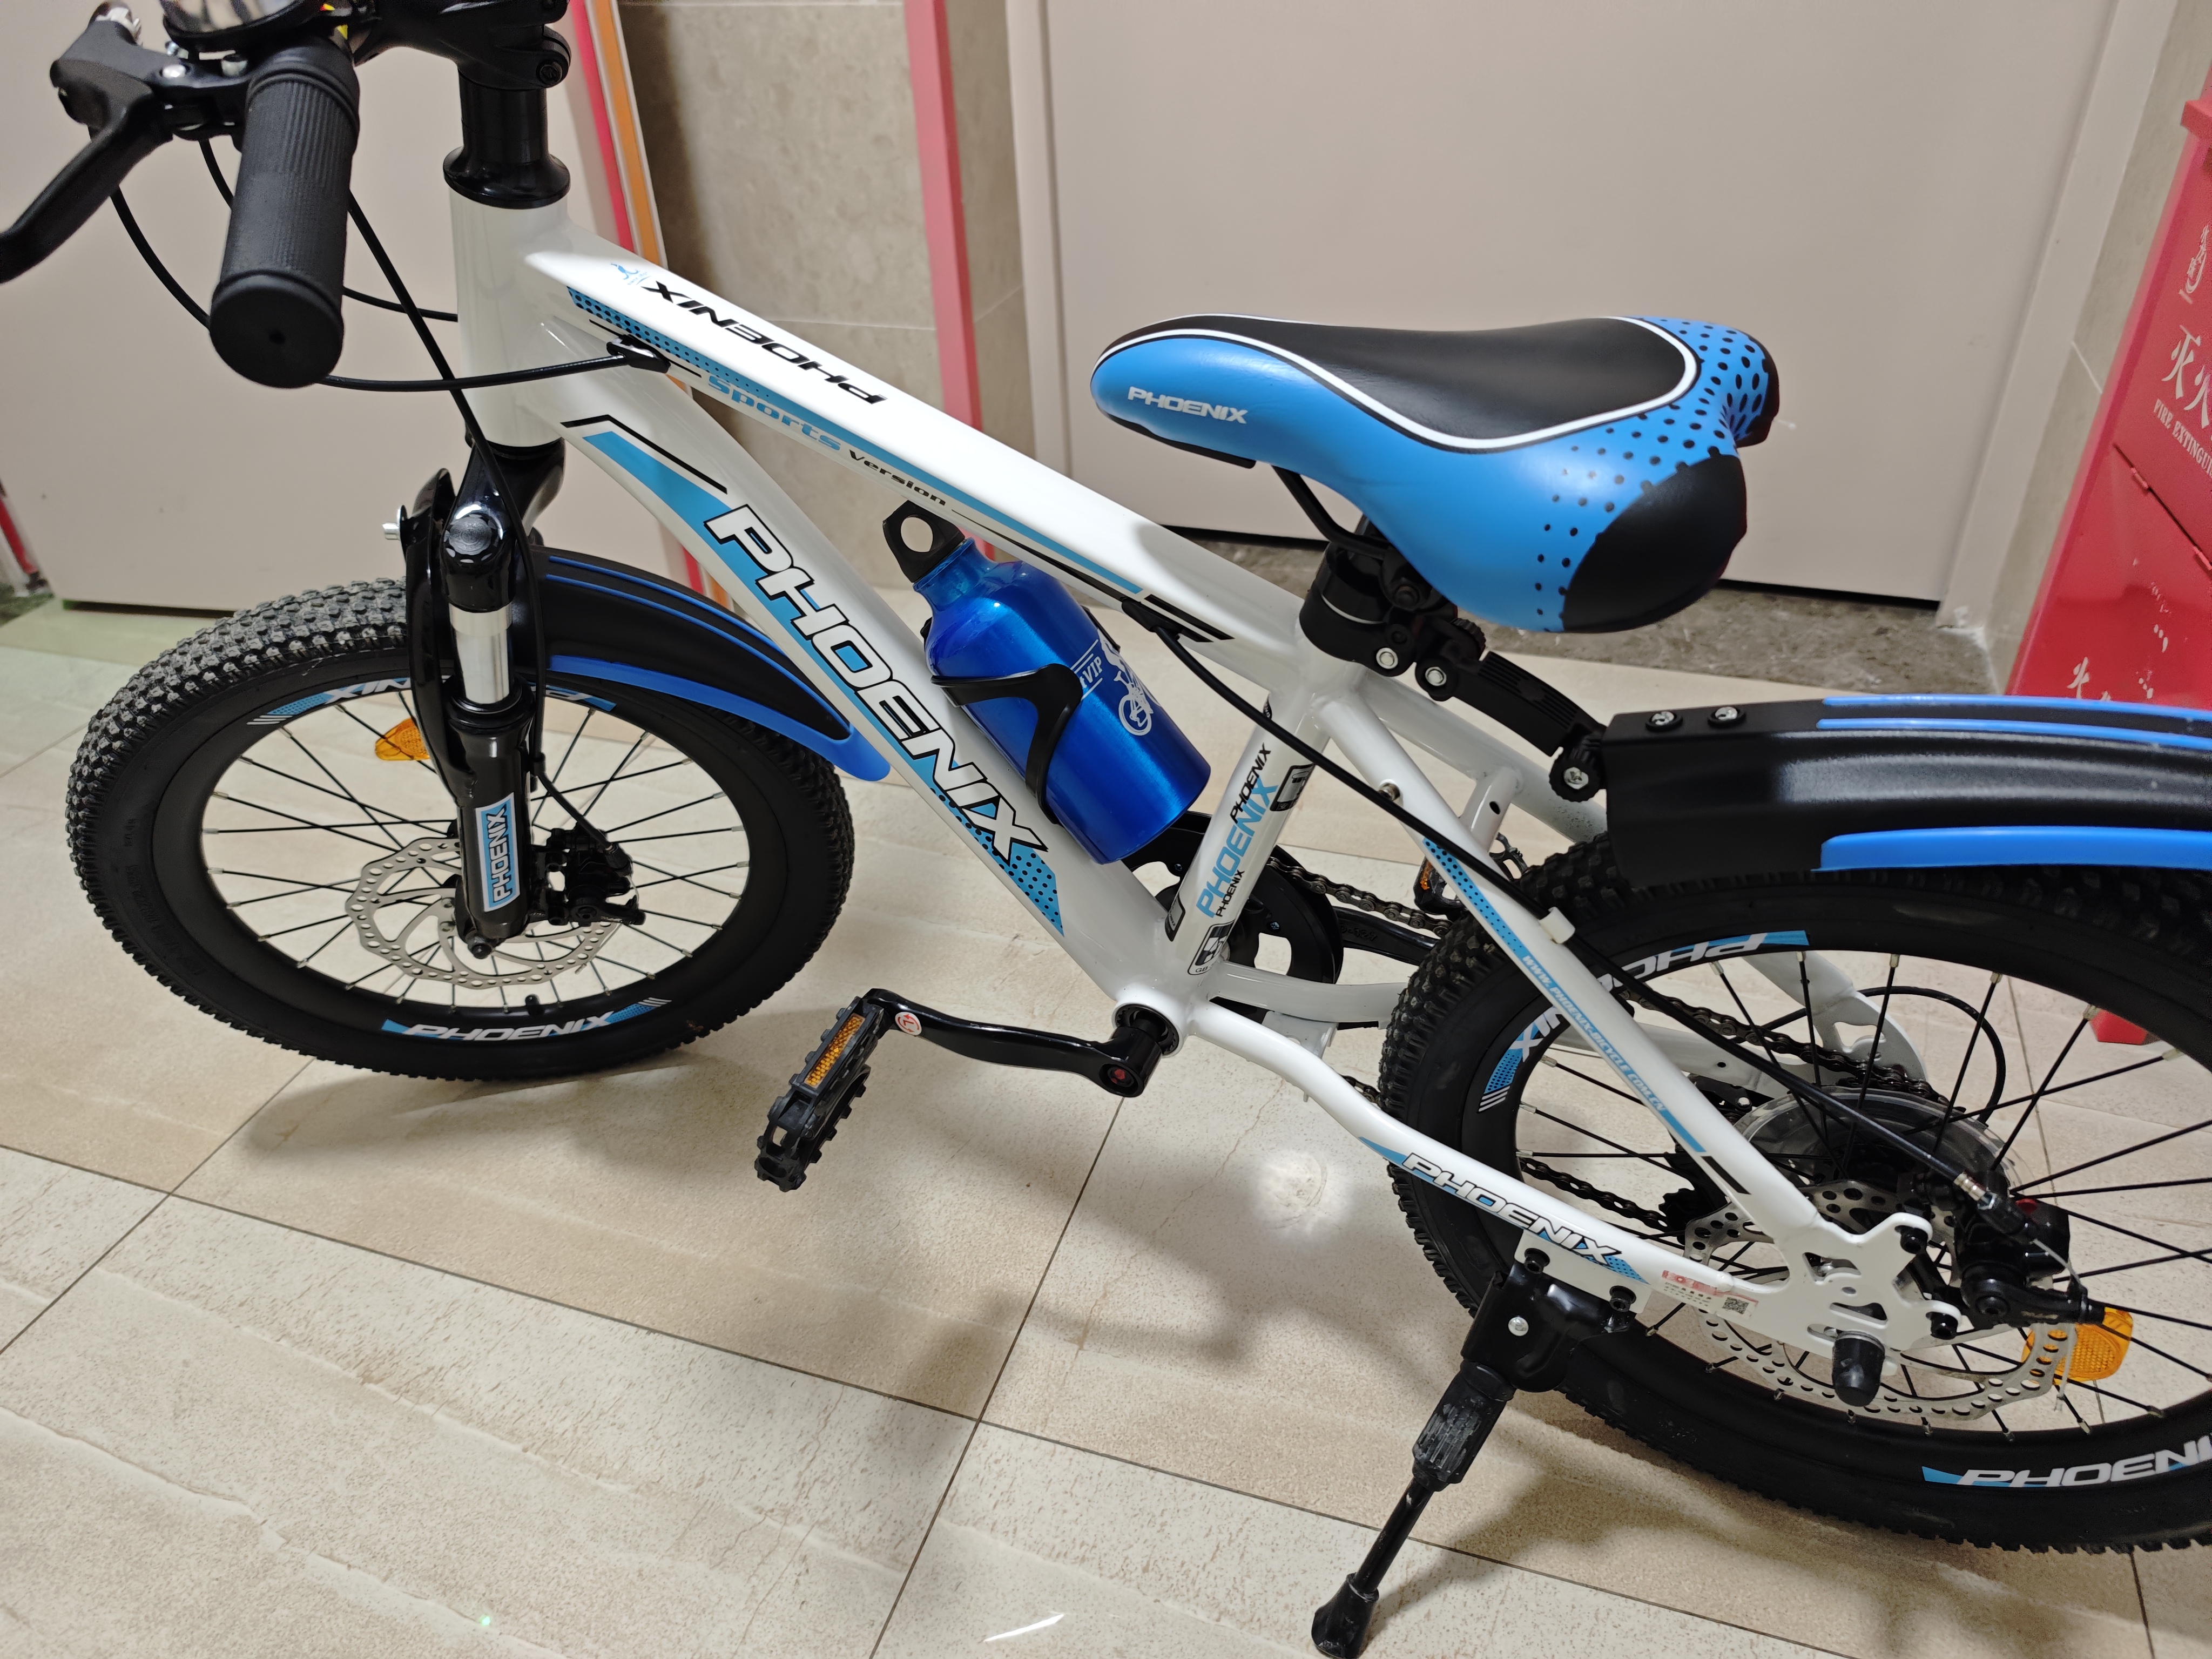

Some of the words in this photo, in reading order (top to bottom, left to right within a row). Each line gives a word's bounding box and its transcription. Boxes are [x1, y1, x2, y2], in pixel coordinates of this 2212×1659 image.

[640, 280, 888, 404] PHOENIX
[709, 375, 841, 451] Sports
[849, 449, 946, 506] Version
[1127, 386, 1249, 424] PHOENIX
[2172, 420, 2212, 479] EXTINGUI
[703, 504, 1049, 866] PHOENIX
[1230, 742, 1271, 824] PHOENIX
[486, 804, 512, 904] PHOENIX
[1196, 777, 1278, 918] PHOENIX
[1215, 869, 1245, 917] PHOENIX
[406, 1011, 615, 1041] PHOENIX
[1402, 1151, 1622, 1267] PHOENIX
[1957, 1435, 2212, 1487] PHOENI
